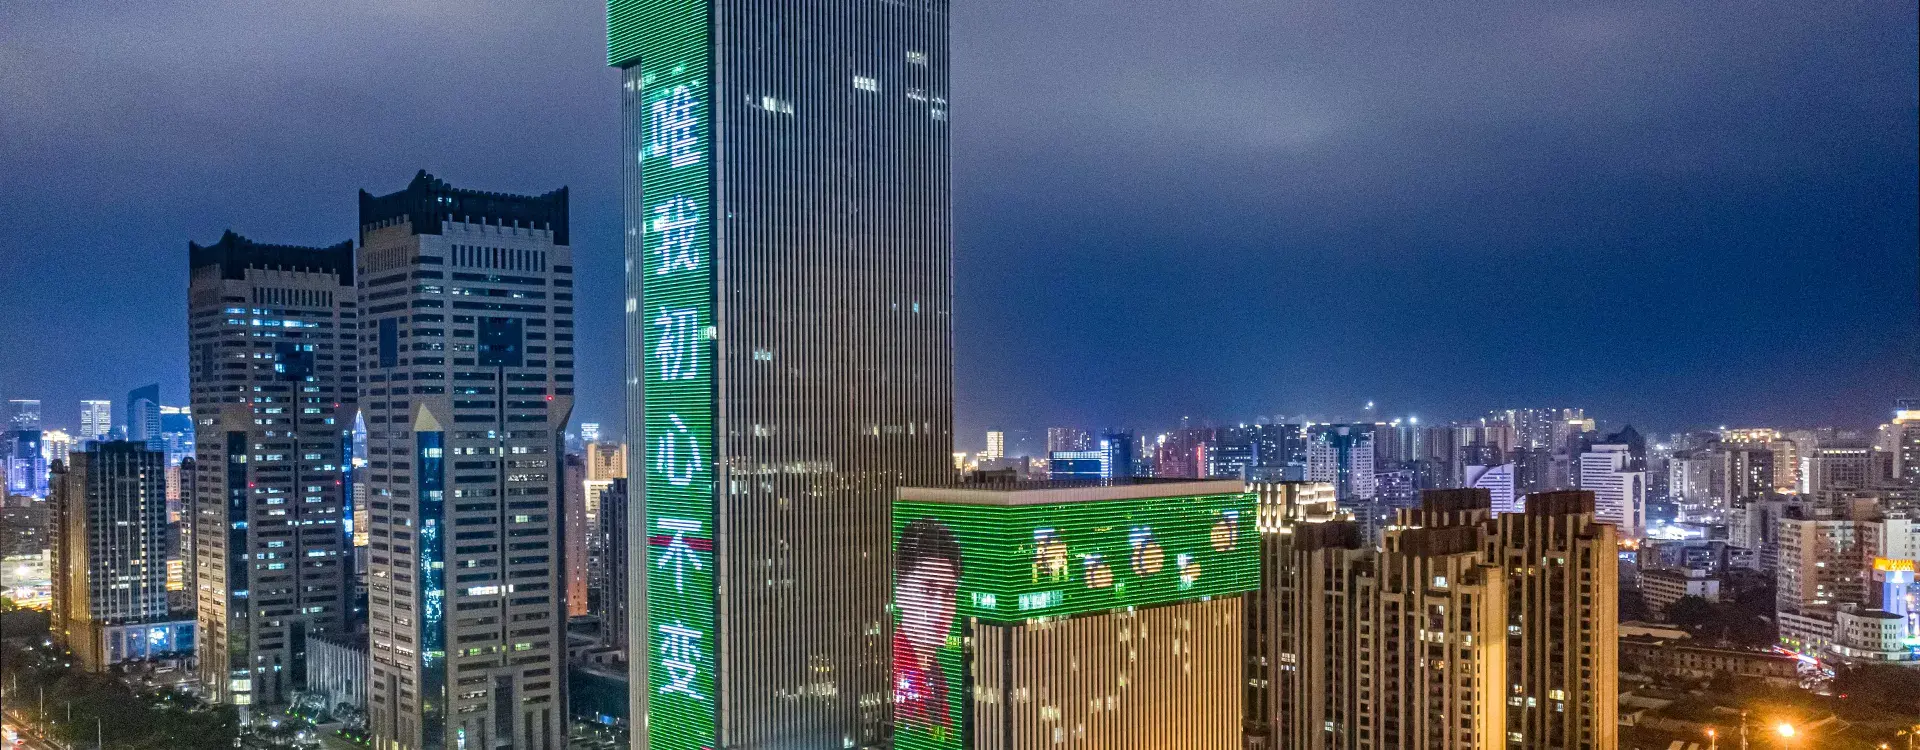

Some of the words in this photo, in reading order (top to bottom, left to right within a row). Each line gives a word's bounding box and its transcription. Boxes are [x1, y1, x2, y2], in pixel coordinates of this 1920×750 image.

[652, 85, 704, 699] 唯我初心不变
